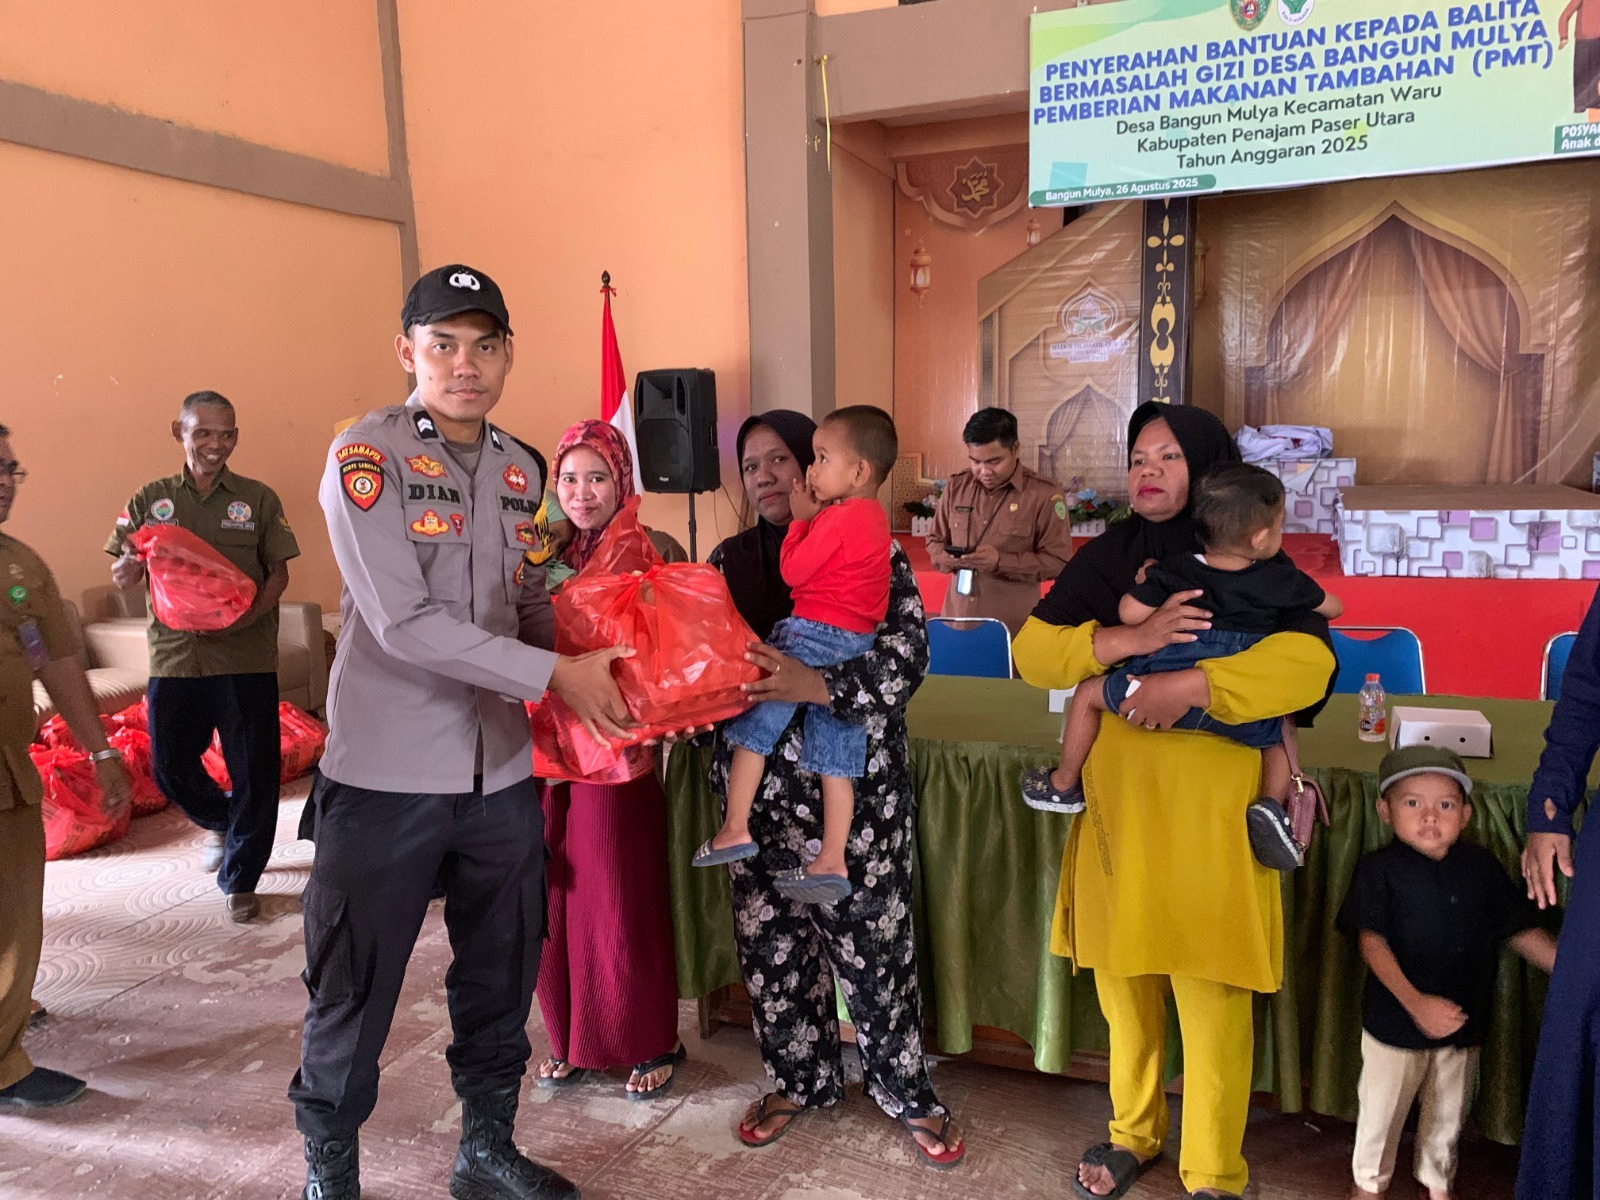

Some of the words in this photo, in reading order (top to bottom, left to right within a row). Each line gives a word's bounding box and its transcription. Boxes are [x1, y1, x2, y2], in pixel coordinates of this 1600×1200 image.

[1046, 44, 1198, 81] PENYERAHAN
[1206, 27, 1326, 60] BANTUAN
[1335, 10, 1438, 43] KEPADA
[1447, 0, 1541, 27] BALITA
[1039, 68, 1188, 104] BERMASALAH
[1195, 60, 1245, 83] GIZI
[1253, 52, 1316, 77] DESA
[1324, 33, 1442, 67] BANGUN
[1451, 19, 1548, 50] MULYA
[1033, 93, 1161, 125] PEMBERIAN
[1169, 76, 1297, 110] MAKANAN
[1305, 55, 1454, 92] TAMBAHAN
[1472, 40, 1554, 78] (PMT)
[1116, 119, 1155, 136] Desa
[1160, 112, 1222, 131] Bangun
[1227, 106, 1279, 123] Mulya
[1284, 91, 1384, 116] Kecamatan
[1390, 84, 1442, 101] Waru
[1137, 132, 1226, 153] Kabupaten
[1232, 122, 1306, 144] Penajam
[1311, 116, 1361, 134] Paser
[1366, 110, 1415, 127] Utara
[1561, 136, 1592, 150] Anak
[1562, 123, 1600, 138] POSYA
[1177, 153, 1226, 169] Tahun
[1230, 143, 1316, 166] Anggaran
[1321, 134, 1368, 156] 2025
[1045, 190, 1082, 201] Bangun
[1083, 185, 1114, 198] Mulya,
[1116, 184, 1129, 195] 26
[1130, 181, 1170, 194] Agustus
[1172, 177, 1198, 189] 2025
[349, 444, 381, 462] SAMAPTA
[408, 484, 461, 504] DIAN
